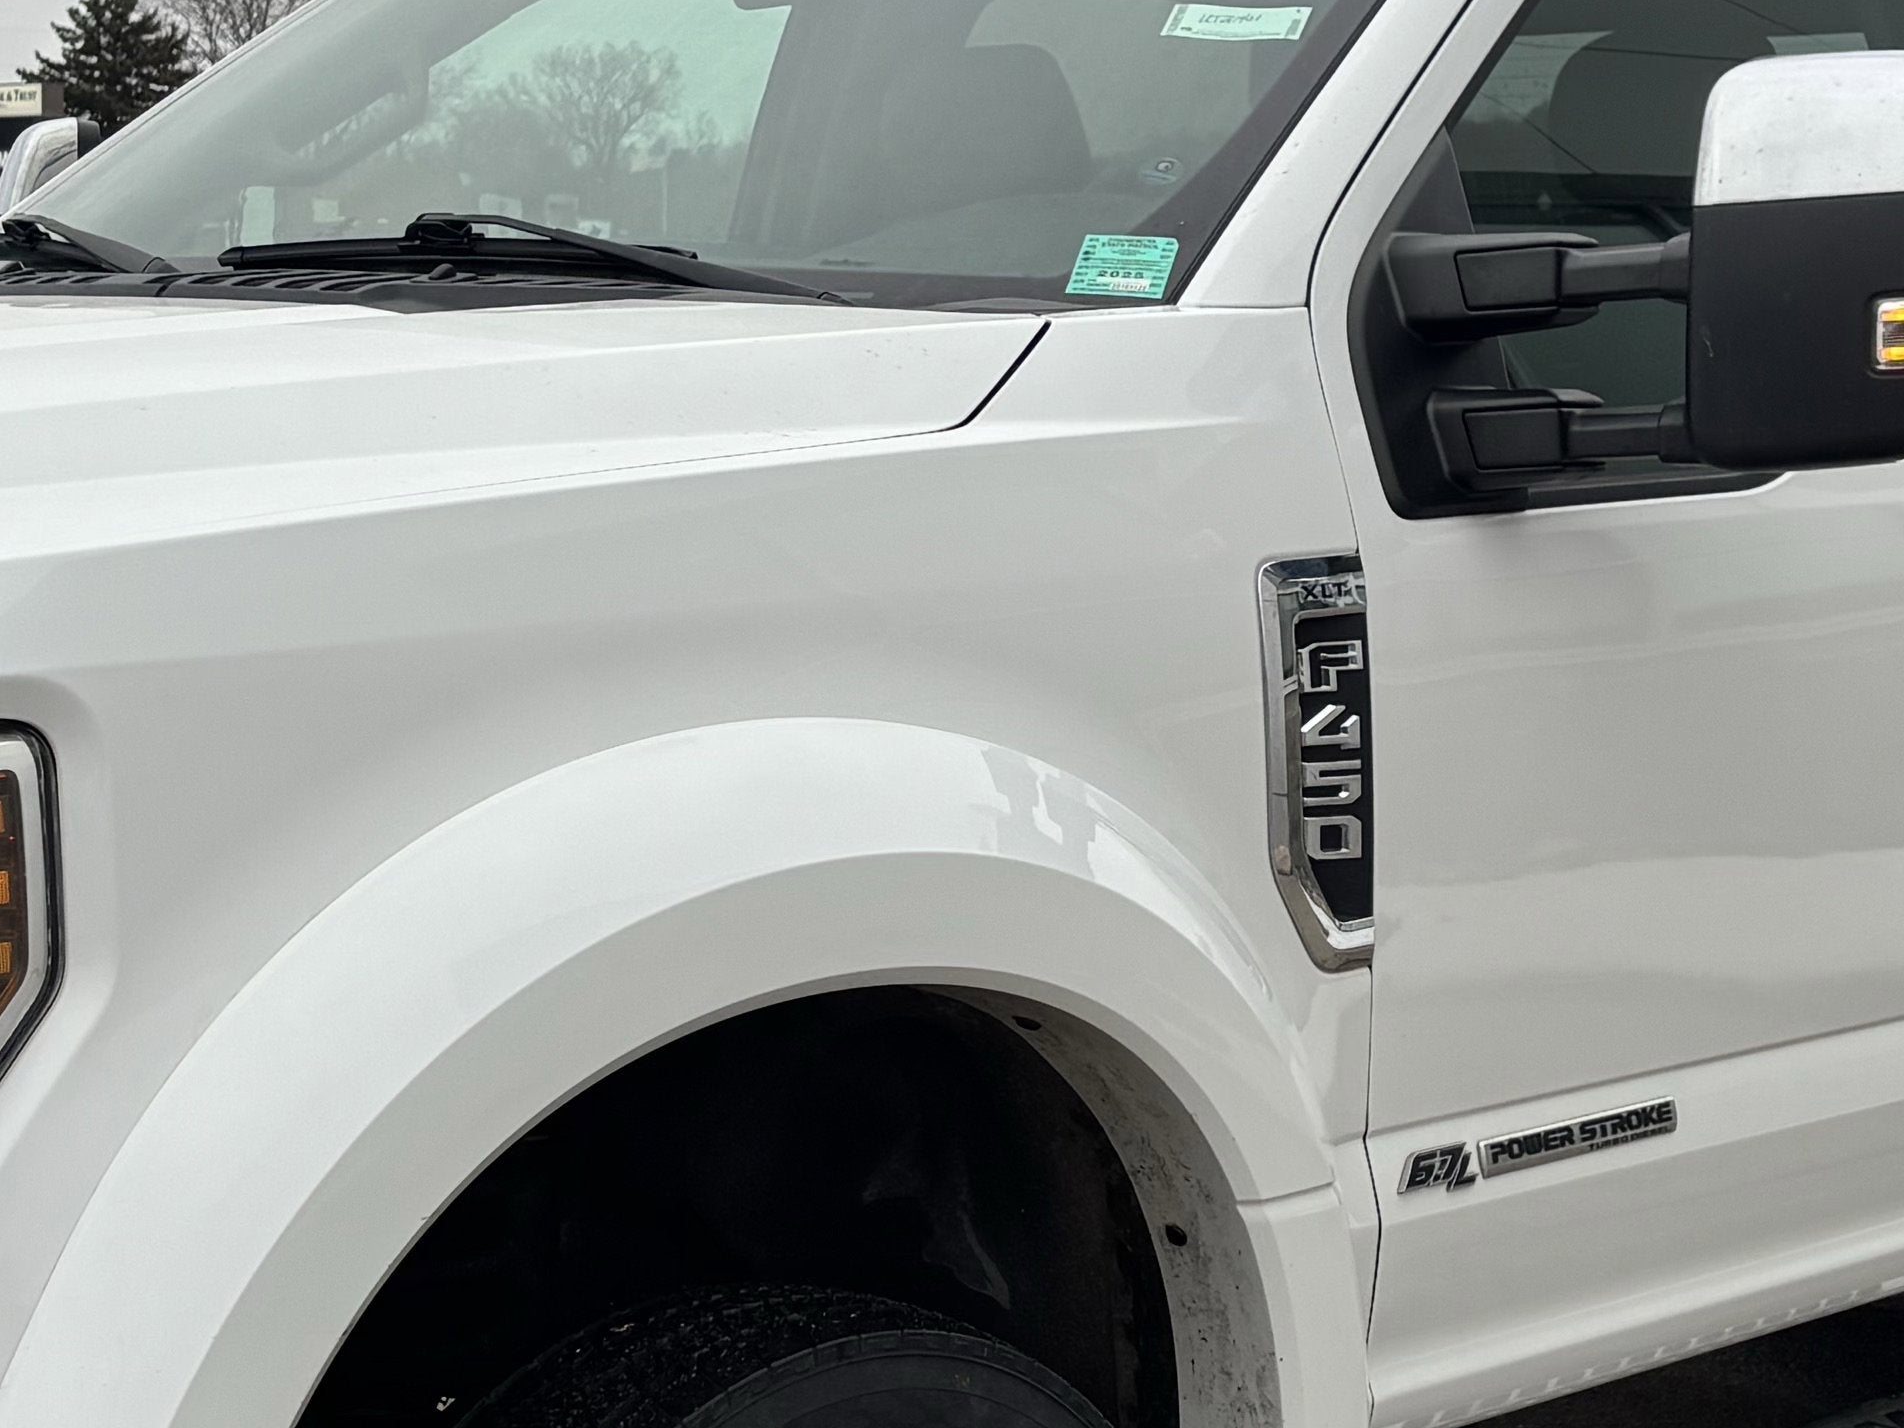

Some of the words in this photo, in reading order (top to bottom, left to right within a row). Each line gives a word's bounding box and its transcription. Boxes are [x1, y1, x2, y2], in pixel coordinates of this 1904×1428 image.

[1301, 580, 1349, 600] XLT
[1298, 639, 1364, 859] F450
[1490, 1122, 1575, 1165] POWER
[1579, 1101, 1673, 1142] STROKE
